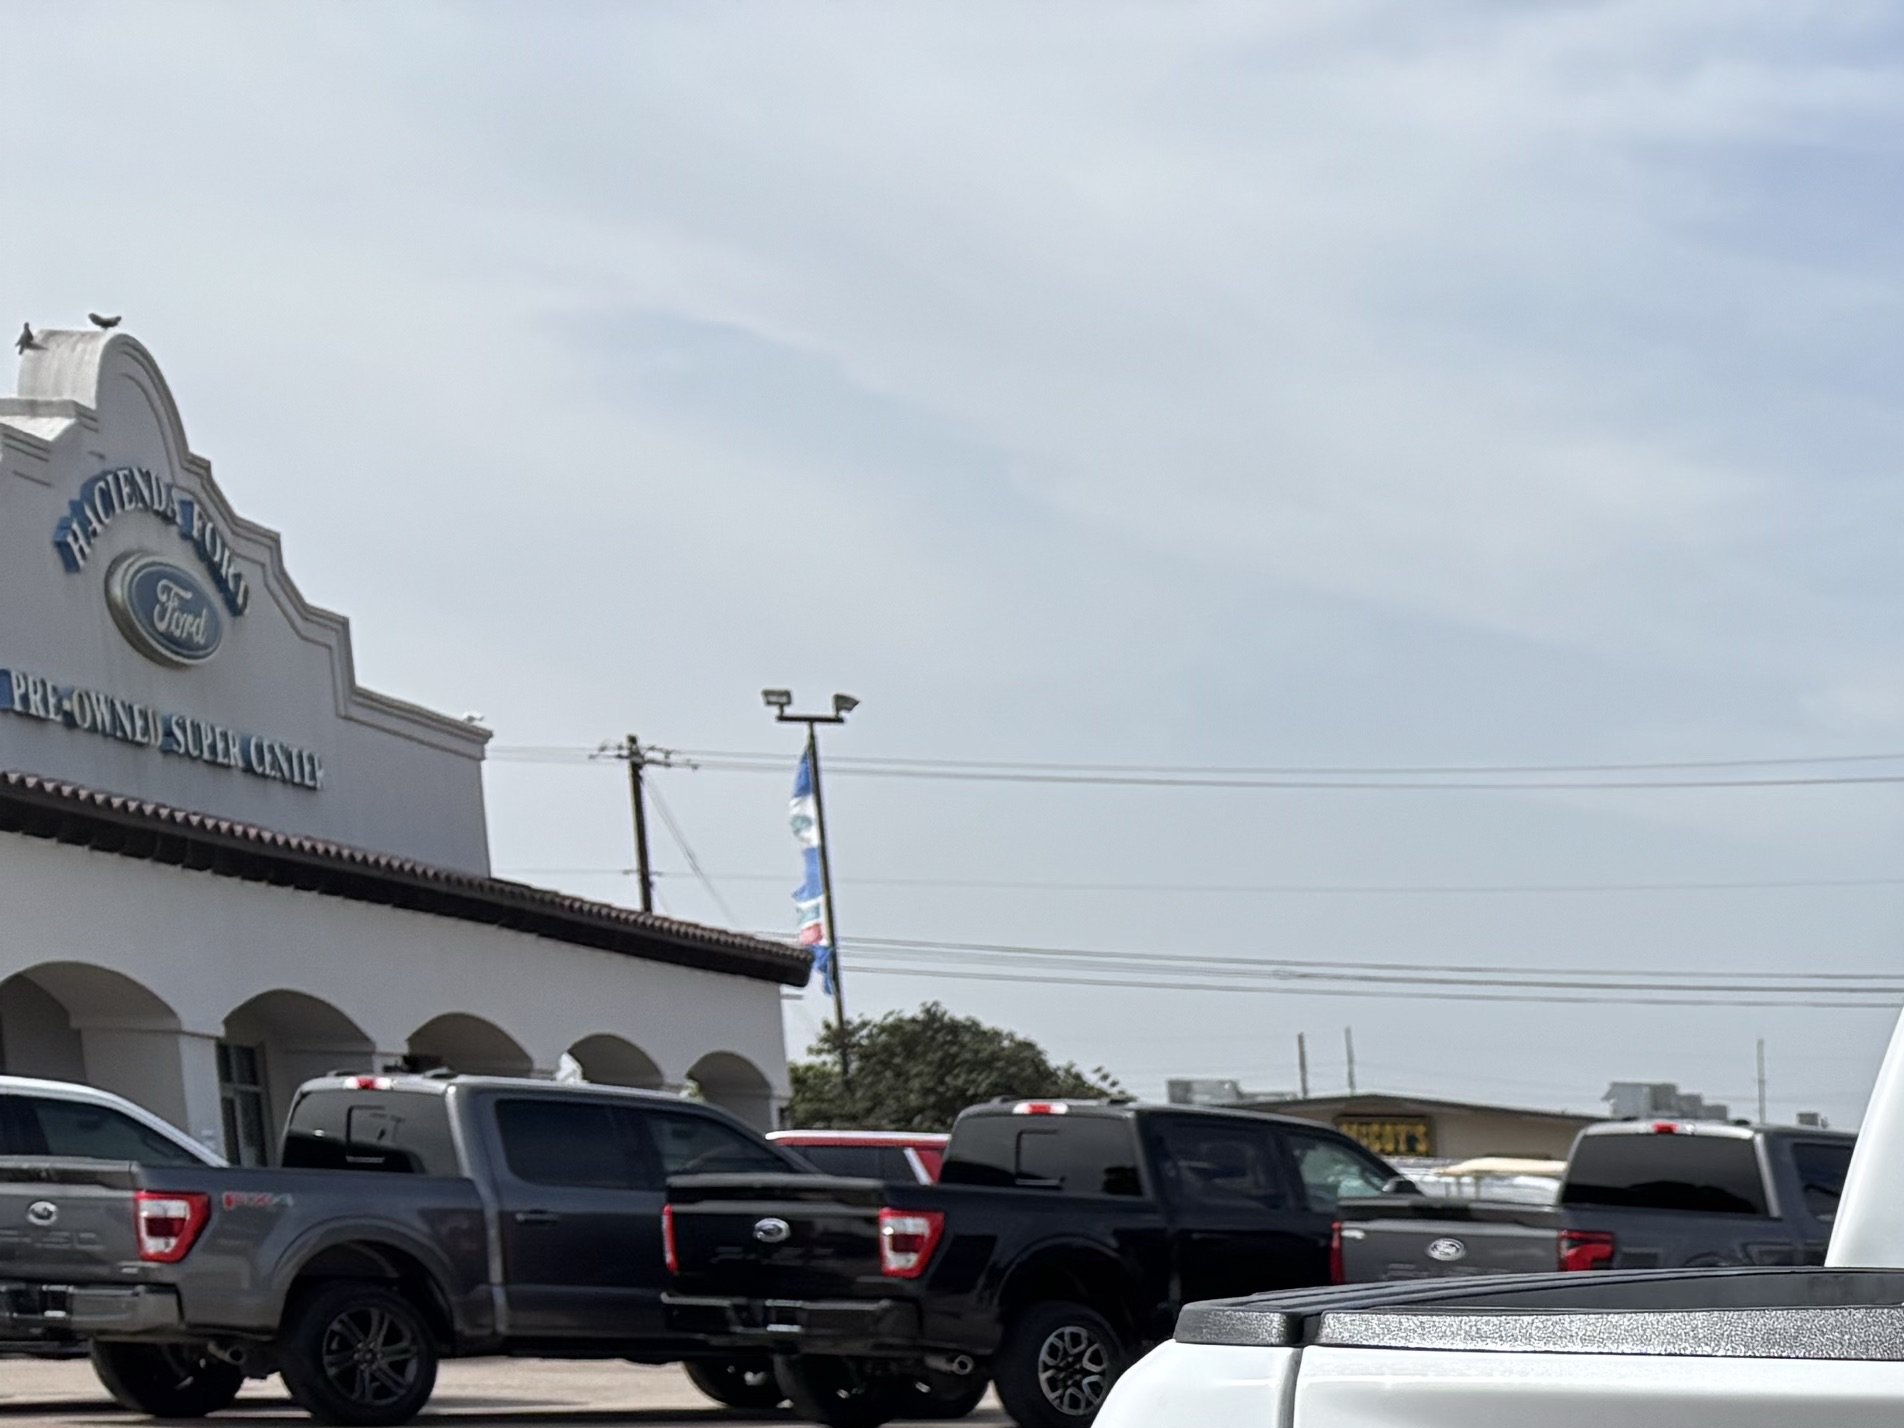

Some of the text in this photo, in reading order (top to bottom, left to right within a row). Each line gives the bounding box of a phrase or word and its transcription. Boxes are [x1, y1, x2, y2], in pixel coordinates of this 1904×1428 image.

[62, 466, 248, 608] HACIENDA FORD
[153, 577, 209, 646] Ford
[10, 671, 325, 790] PRE-OWNED SUPER CENTER
